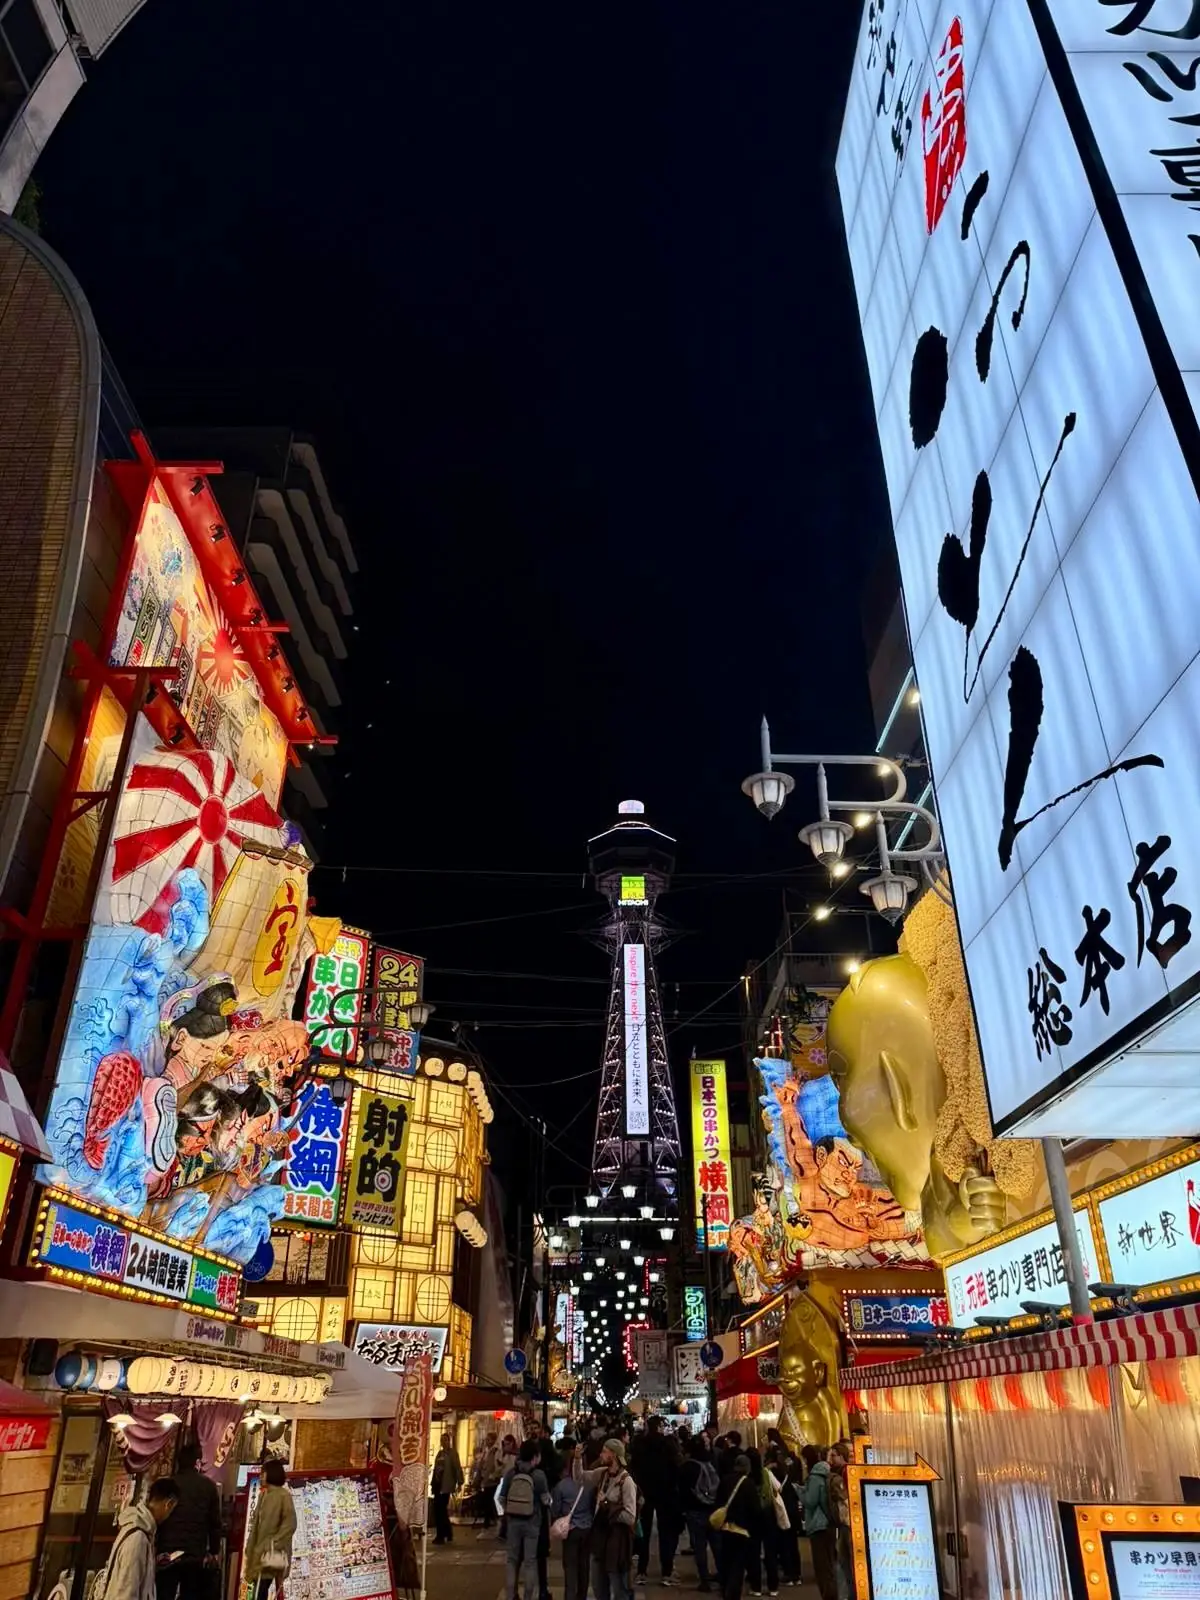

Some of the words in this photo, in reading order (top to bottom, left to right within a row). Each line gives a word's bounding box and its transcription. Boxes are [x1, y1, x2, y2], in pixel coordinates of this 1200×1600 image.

[380, 956, 418, 987] 24
[1027, 835, 1192, 1062] 総本店
[307, 955, 338, 1047] 串かつ
[287, 1081, 343, 1193] 横綱
[701, 1075, 720, 1159] 日本一の串かつ
[357, 1098, 409, 1202] 射的
[91, 1225, 127, 1276] 横綱
[1118, 1210, 1184, 1262] 新世界
[126, 1242, 189, 1293] 24時間営業
[965, 1243, 1067, 1310] 元祖串カツ専門店
[863, 1304, 929, 1324] 日本一の串かつ
[1129, 1550, 1200, 1567] 串カツ早見
